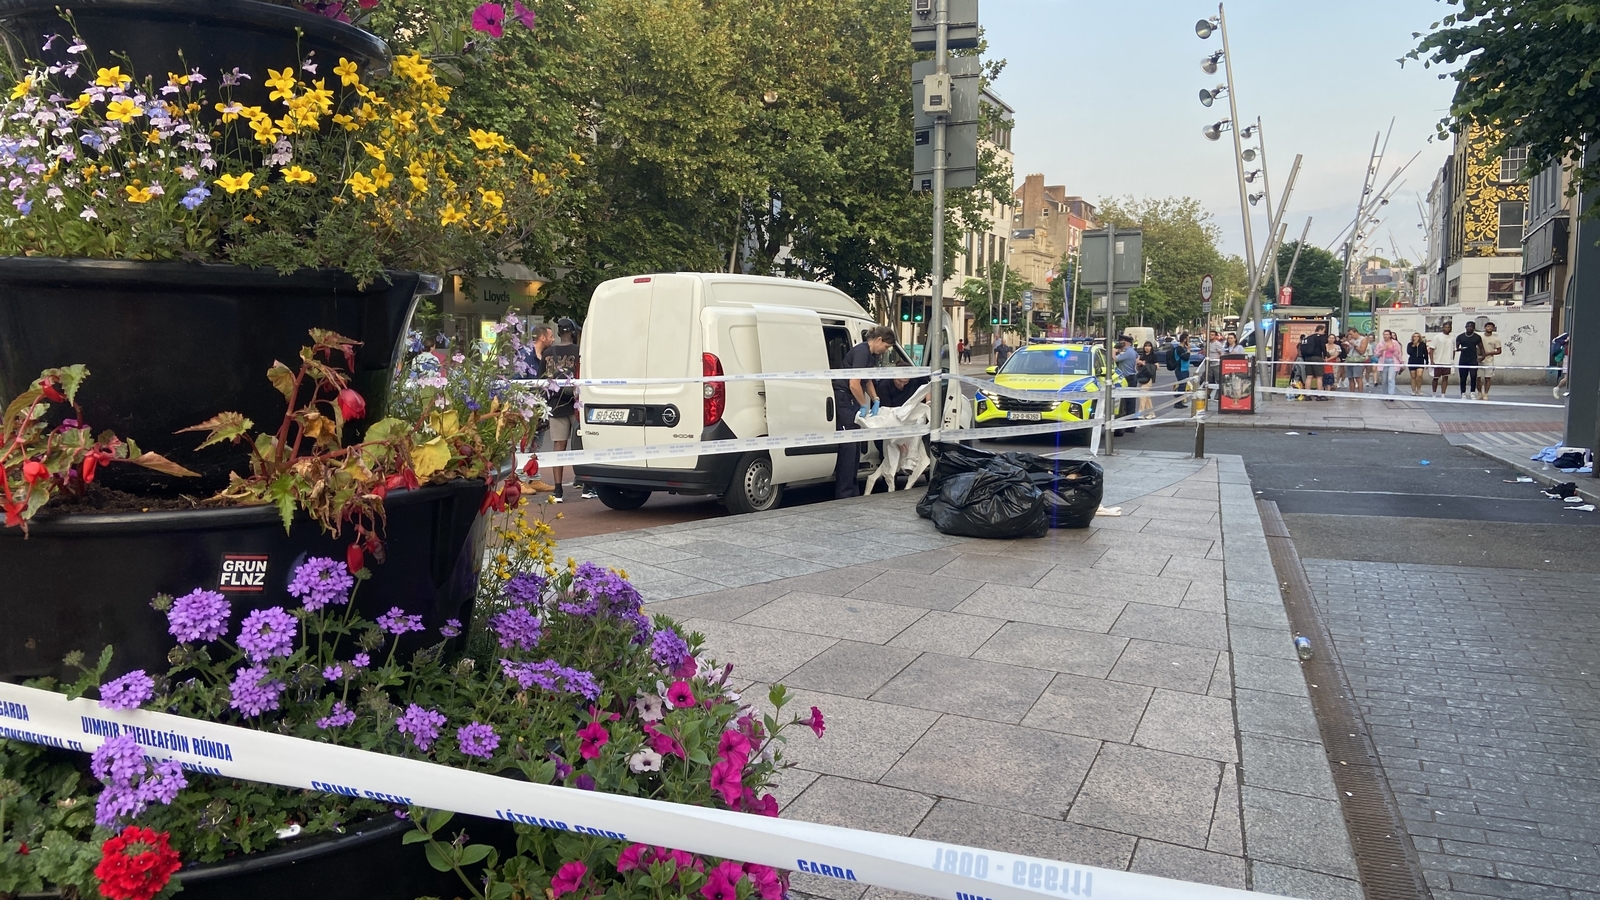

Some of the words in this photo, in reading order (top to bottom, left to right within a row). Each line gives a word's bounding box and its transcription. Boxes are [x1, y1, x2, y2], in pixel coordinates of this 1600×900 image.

[222, 560, 268, 573] GRUN
[220, 572, 266, 586] FLNZ
[81, 715, 121, 739] UIMHIR
[192, 735, 234, 762] RÚNDA
[797, 858, 858, 882] GARDA
